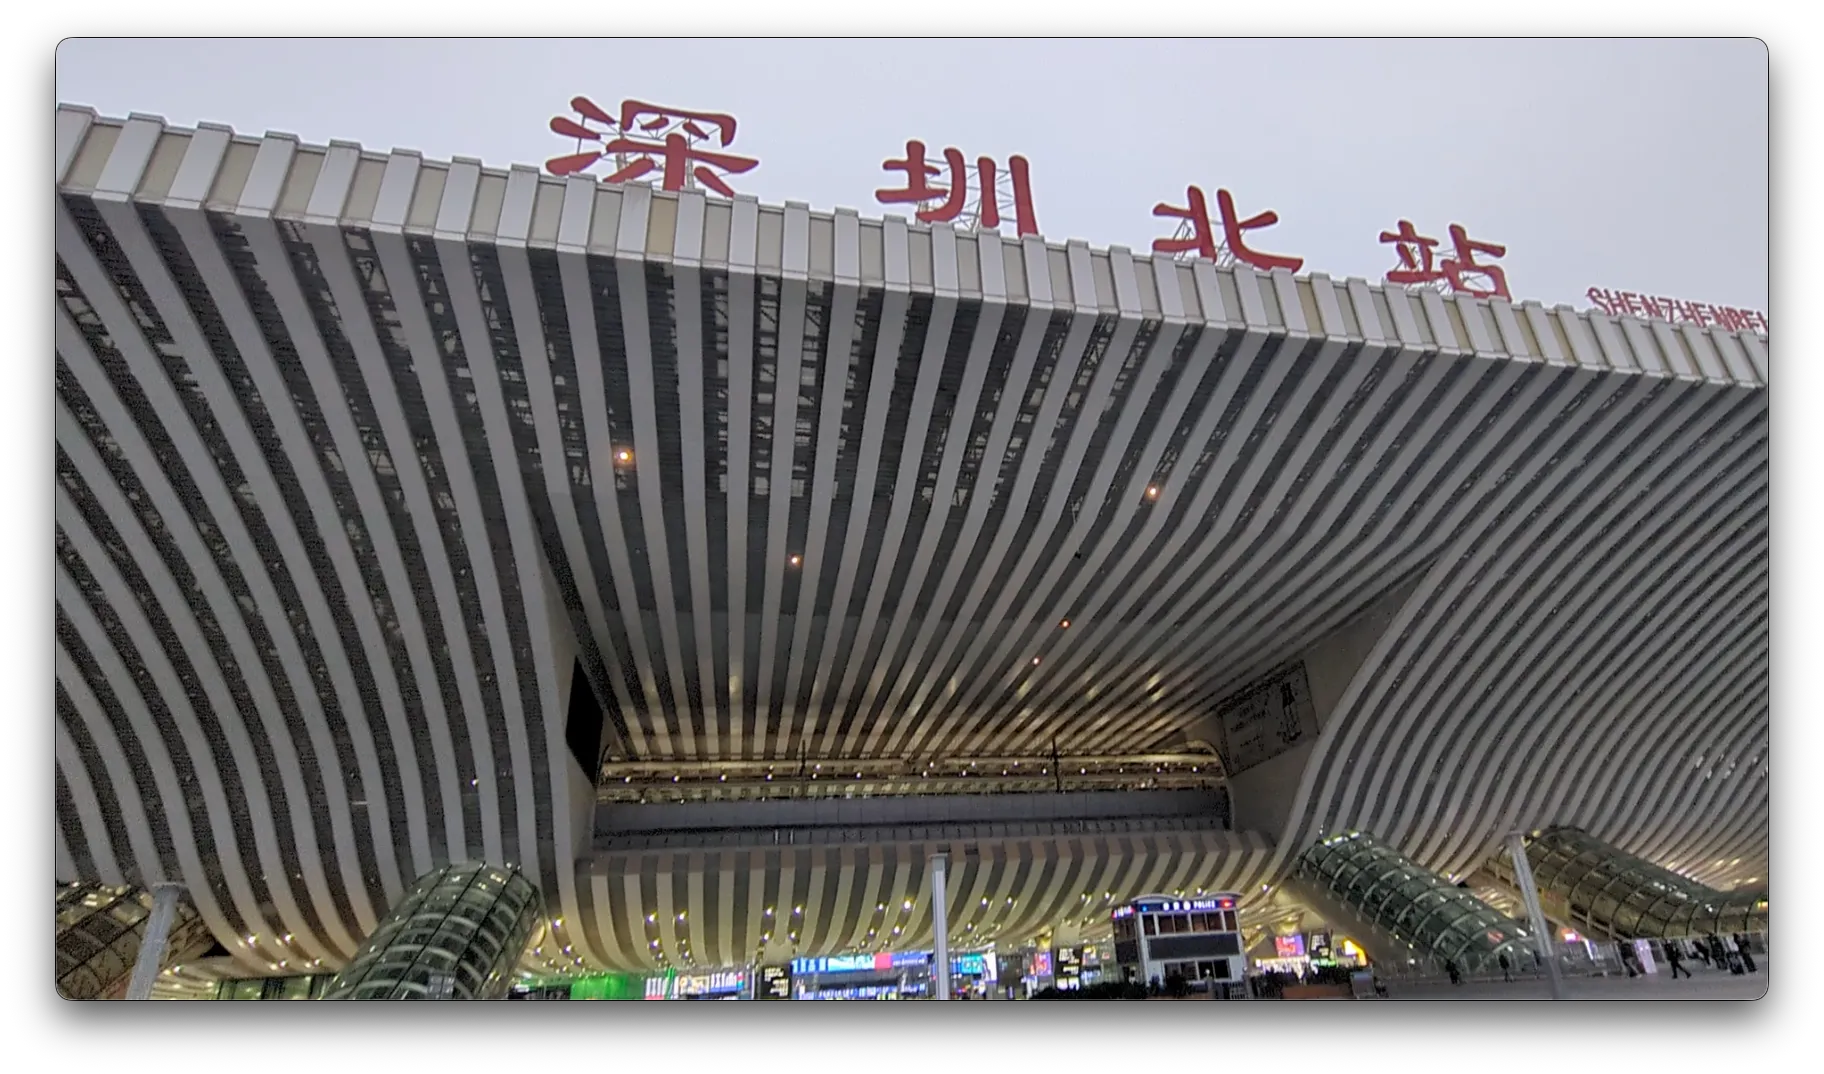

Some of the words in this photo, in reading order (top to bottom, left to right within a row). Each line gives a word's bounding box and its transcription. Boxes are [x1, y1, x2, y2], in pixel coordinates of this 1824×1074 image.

[546, 96, 1511, 303] 深圳北站
[1193, 899, 1216, 910] POLICE
